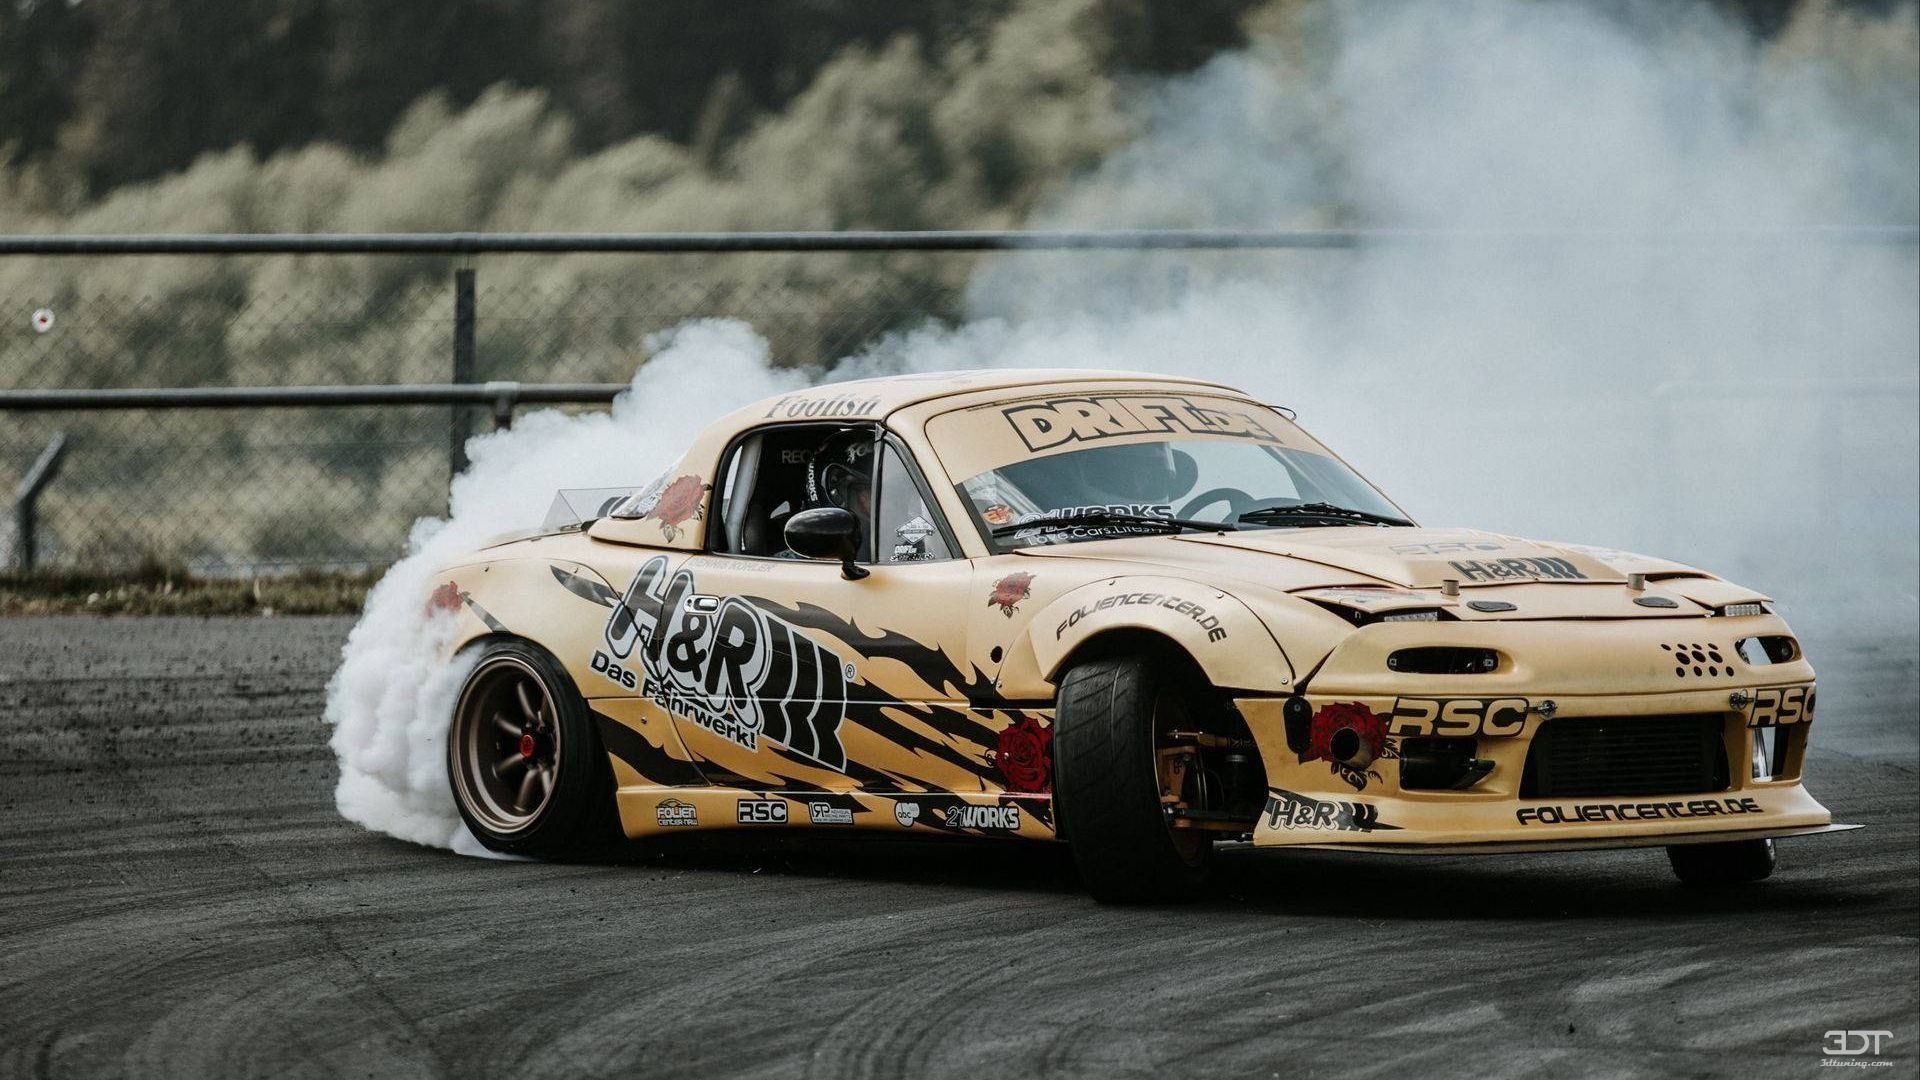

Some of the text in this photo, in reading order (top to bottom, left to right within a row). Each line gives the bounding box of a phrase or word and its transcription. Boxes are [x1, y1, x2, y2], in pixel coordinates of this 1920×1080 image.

[763, 395, 880, 418] Foolish
[1448, 557, 1542, 583] H&R
[591, 650, 756, 750] Das Fahrwerk!
[1388, 698, 1529, 737] RSC
[739, 802, 786, 821] RSC
[946, 805, 1020, 828] 21WORKS
[1268, 800, 1340, 831] H&R
[1516, 797, 1764, 826] FOLIENCENTER.DE
